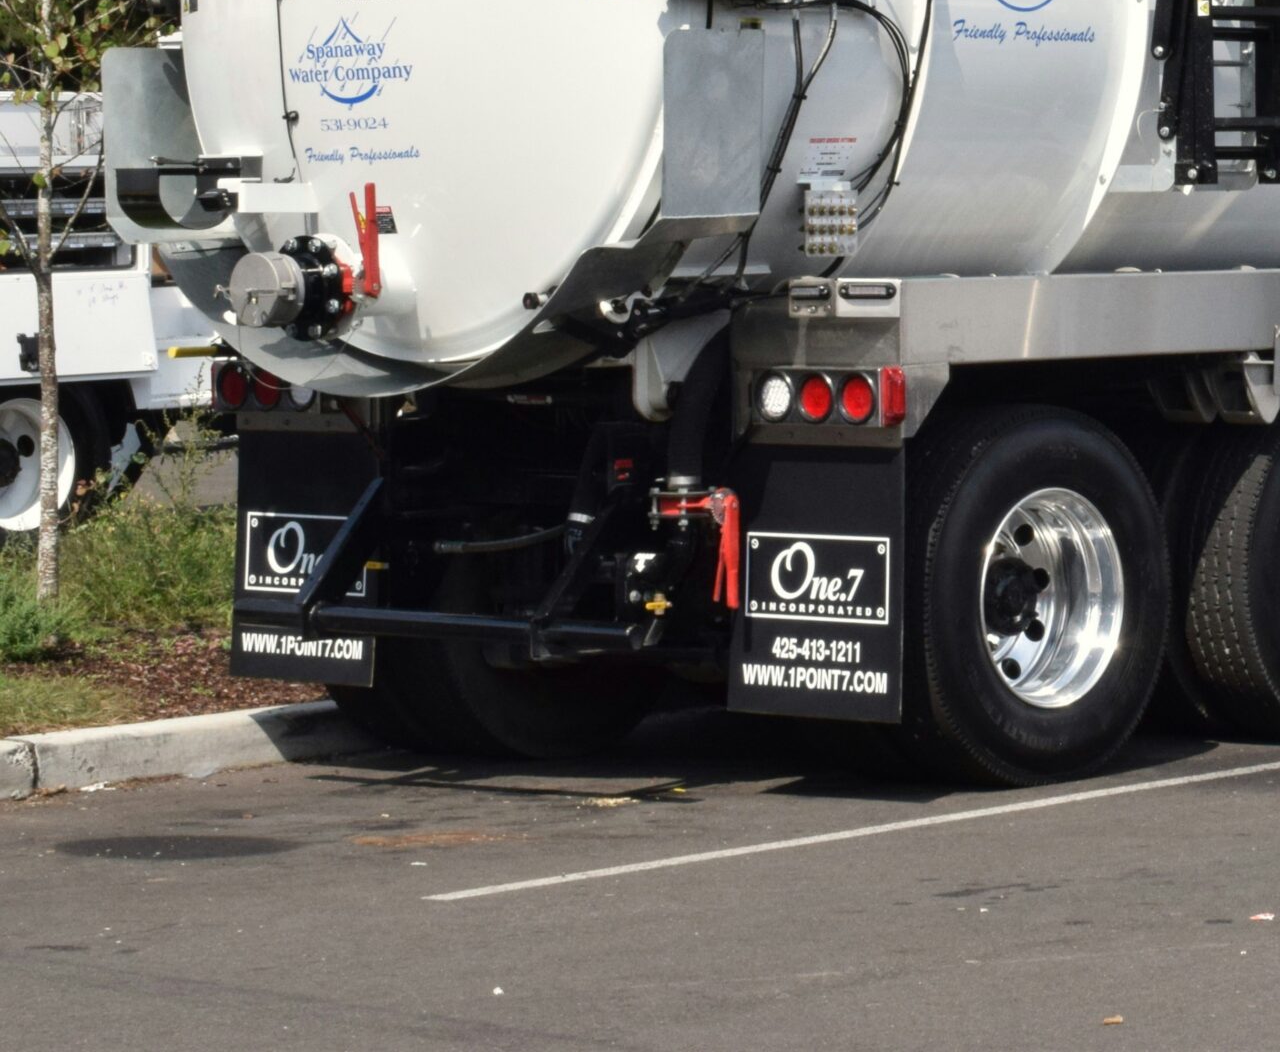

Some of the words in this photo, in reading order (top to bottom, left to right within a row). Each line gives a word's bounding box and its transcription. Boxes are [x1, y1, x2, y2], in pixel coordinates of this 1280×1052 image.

[953, 19, 1007, 44] Friendly
[1013, 21, 1095, 47] Professionals
[306, 42, 386, 63] Spanaway
[288, 68, 329, 83] Water
[334, 64, 413, 83] Company
[320, 117, 389, 131] 531-9024
[305, 147, 344, 164] Friendly
[349, 146, 420, 165] Professionals
[771, 541, 864, 602] One.7
[762, 601, 872, 617] INCORPORATED
[242, 632, 363, 660] WWW.1POINT7.COM
[772, 637, 861, 663] 425-413-1211
[742, 663, 888, 694] WWW.1POINT7.COM
